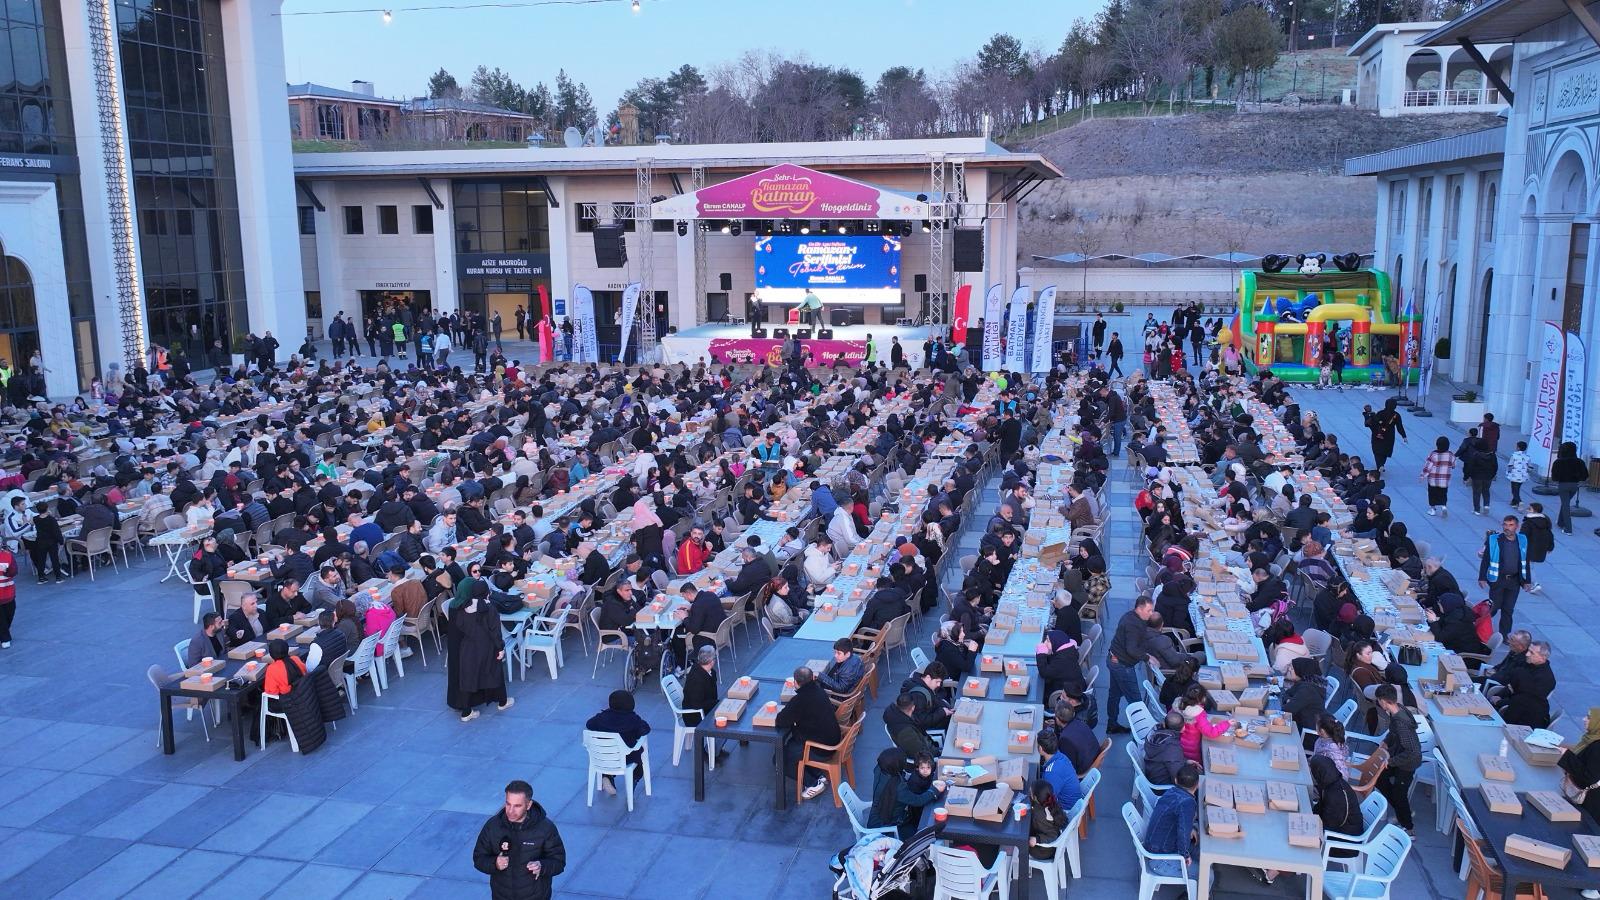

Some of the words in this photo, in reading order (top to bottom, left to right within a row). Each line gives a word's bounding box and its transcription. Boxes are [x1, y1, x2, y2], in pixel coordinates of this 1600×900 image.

[24, 158, 51, 168] SALONU
[751, 188, 815, 203] Batman
[820, 202, 873, 214] Hoşgeldiniz
[485, 267, 503, 275] KURSU
[504, 267, 512, 275] VE
[513, 266, 532, 275] TAZİYE
[533, 266, 542, 275] EVİ
[1008, 320, 1017, 357] BATMAN
